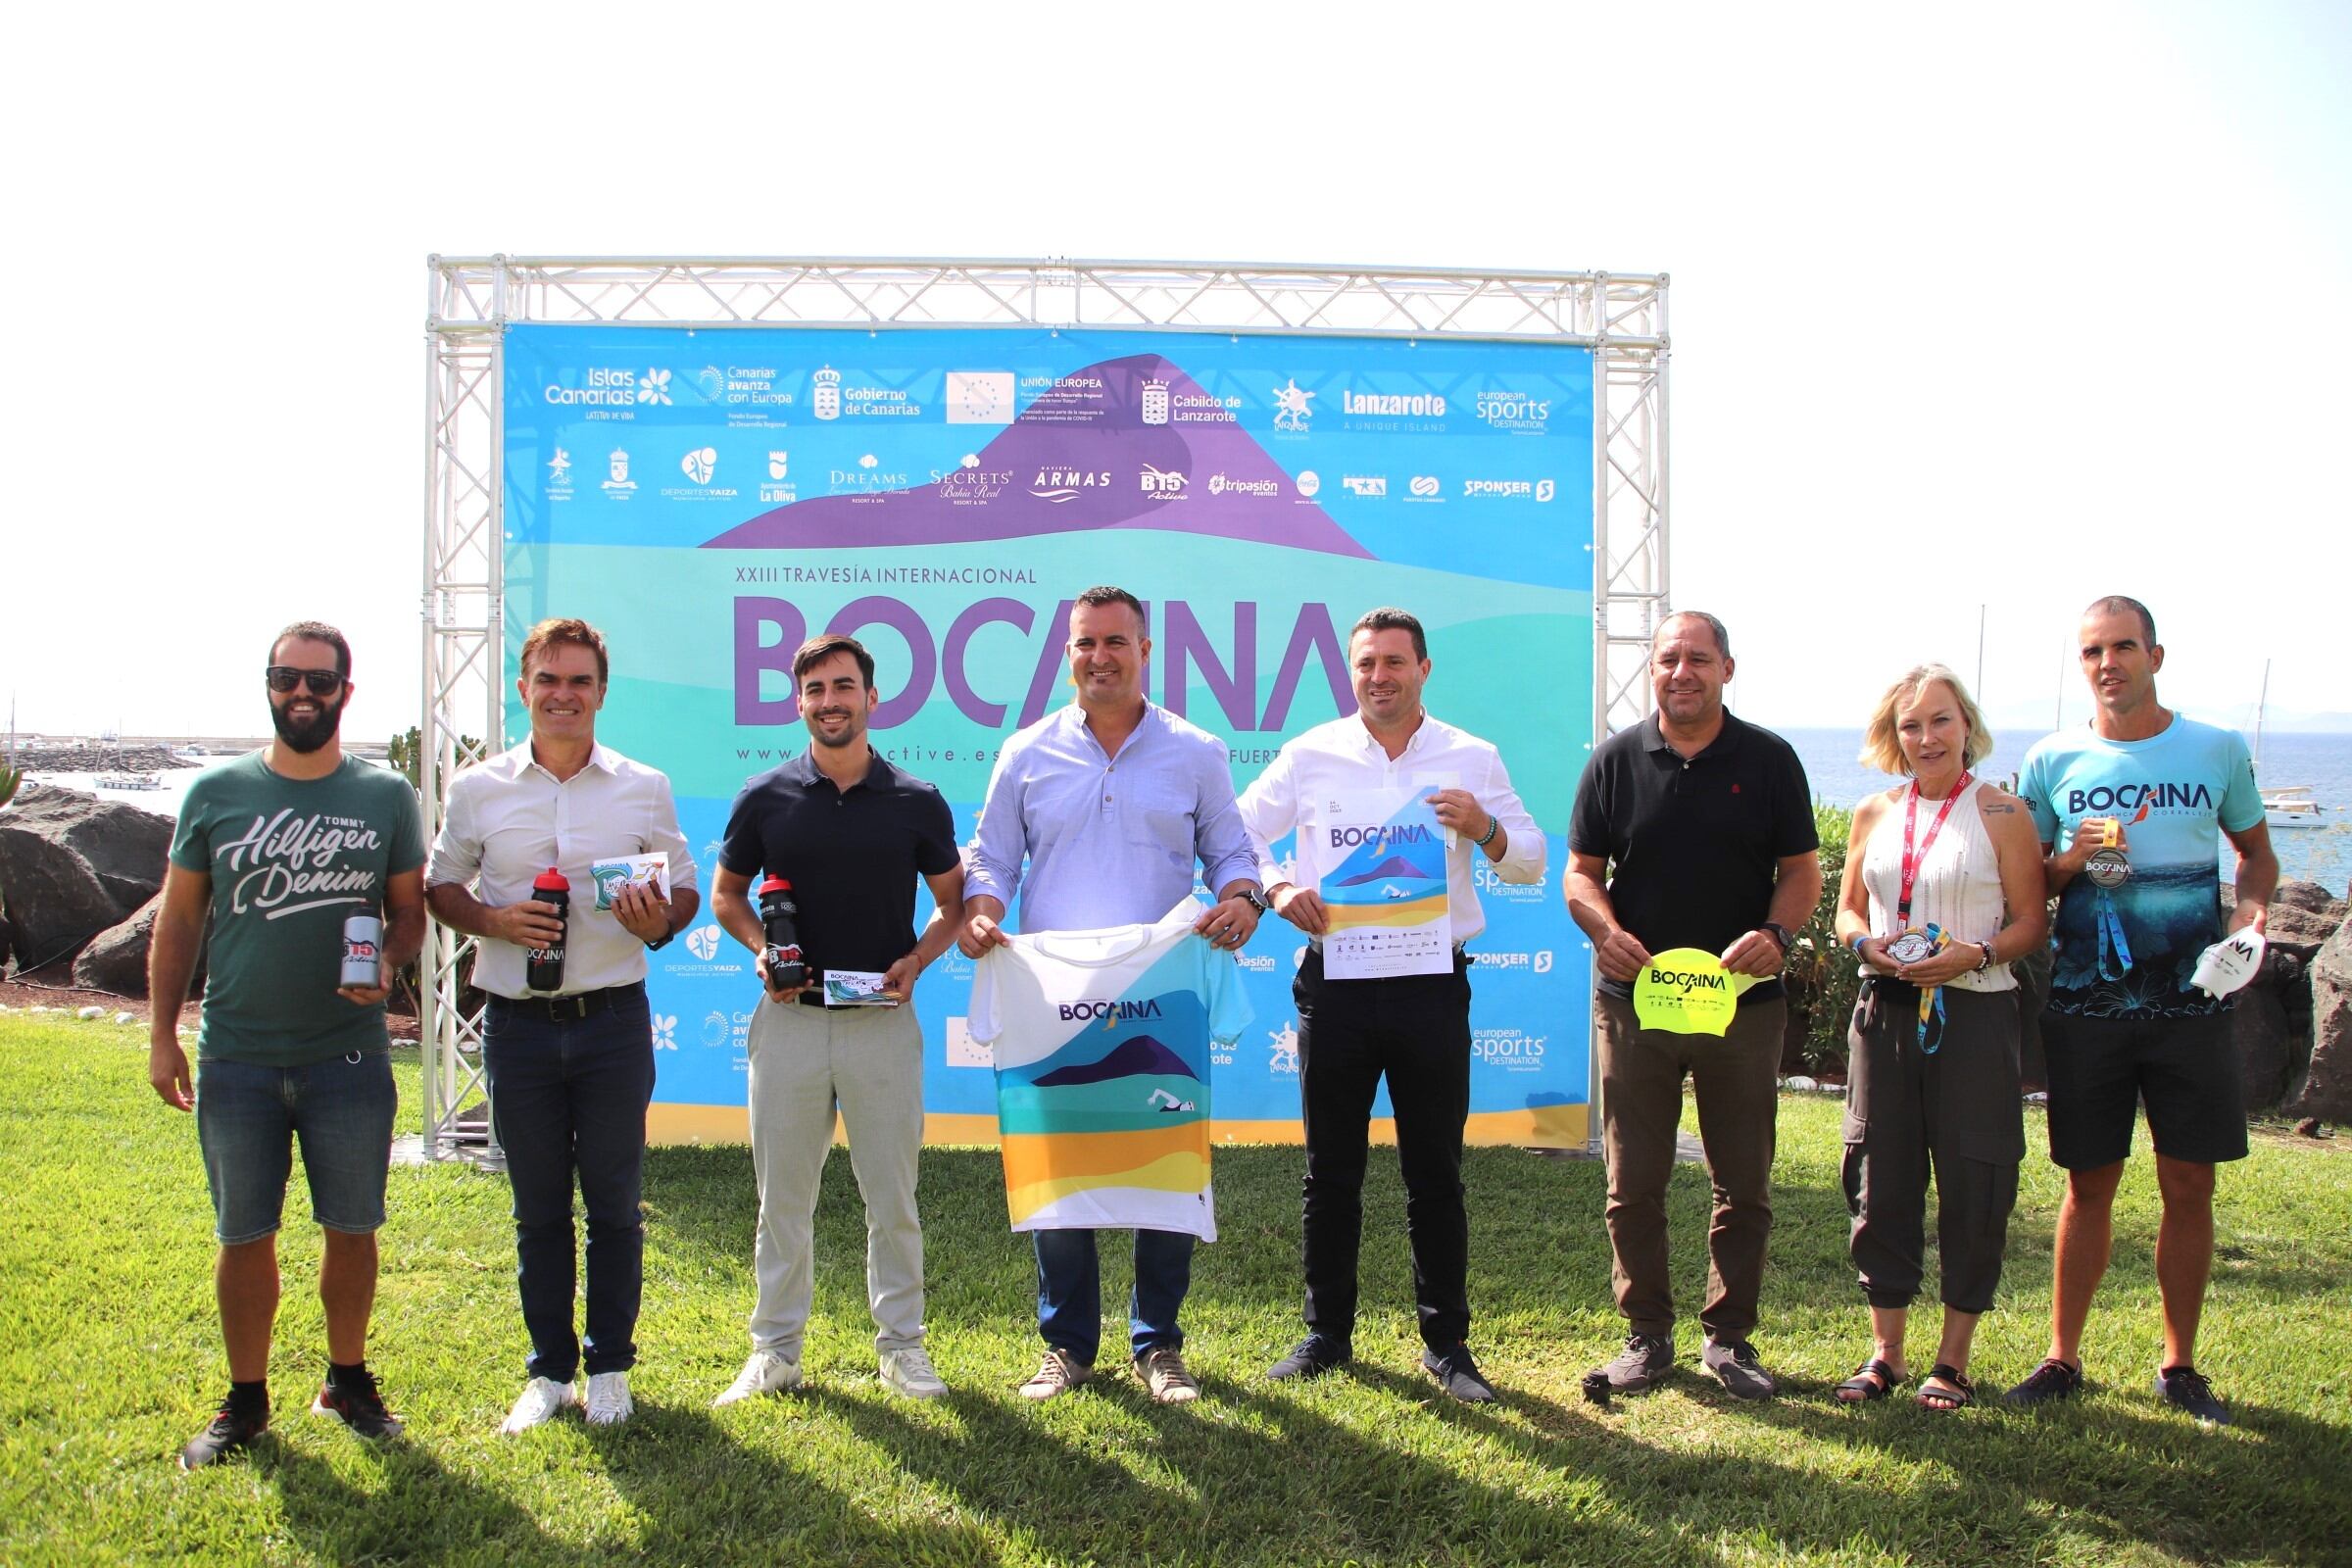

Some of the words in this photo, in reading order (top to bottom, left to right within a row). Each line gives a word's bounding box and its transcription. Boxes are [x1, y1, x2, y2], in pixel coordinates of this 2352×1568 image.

[589, 368, 635, 387] Islas
[727, 367, 776, 378] Canarias
[727, 381, 771, 391] avanza
[1020, 376, 1053, 387] UNIÓN
[1054, 378, 1102, 388] EUROPEA
[545, 385, 635, 405] Canarias
[727, 393, 749, 404] con
[752, 392, 792, 407] Europa
[845, 388, 906, 401] Gobierno
[1477, 391, 1526, 402] european
[1173, 395, 1222, 409] Cabildo
[1225, 396, 1242, 409] de
[1344, 390, 1446, 416] Lanzarote
[845, 404, 861, 416] de
[862, 403, 920, 416] Canarias
[1173, 409, 1237, 422] Lanzarote
[1476, 400, 1548, 424] sports
[1356, 422, 1398, 431] UNIQUE
[1404, 422, 1446, 432] ISLAND
[1494, 420, 1544, 429] DESTINATION
[831, 470, 907, 484] DREAMS
[1034, 472, 1111, 487] ARMAS
[973, 484, 1001, 499] Real
[1226, 479, 1278, 494] tripasión
[1464, 480, 1531, 497] SPONSER
[760, 490, 770, 502] La
[773, 490, 796, 502] Oliva
[736, 567, 777, 582] XXIII
[783, 564, 872, 583] TRAVESÍA
[878, 567, 1037, 584] INTERNACIONAL
[2069, 783, 2212, 814] BOCAINA
[323, 815, 366, 828] TOMMY
[217, 808, 381, 871] Hilfiger
[1330, 823, 1431, 849] BOCAINA
[2085, 862, 2132, 873] BOCAINA
[233, 862, 376, 913] Denim
[1492, 887, 1543, 896] DESTINATION
[527, 947, 564, 960] OCAINA
[1889, 941, 1934, 952] BOCAINA
[1465, 953, 1529, 968] PONSER
[1651, 969, 1726, 991] BOCAINA
[1059, 1000, 1162, 1021] BOCAINA
[1473, 1029, 1522, 1040] european
[1473, 1036, 1544, 1061] sports
